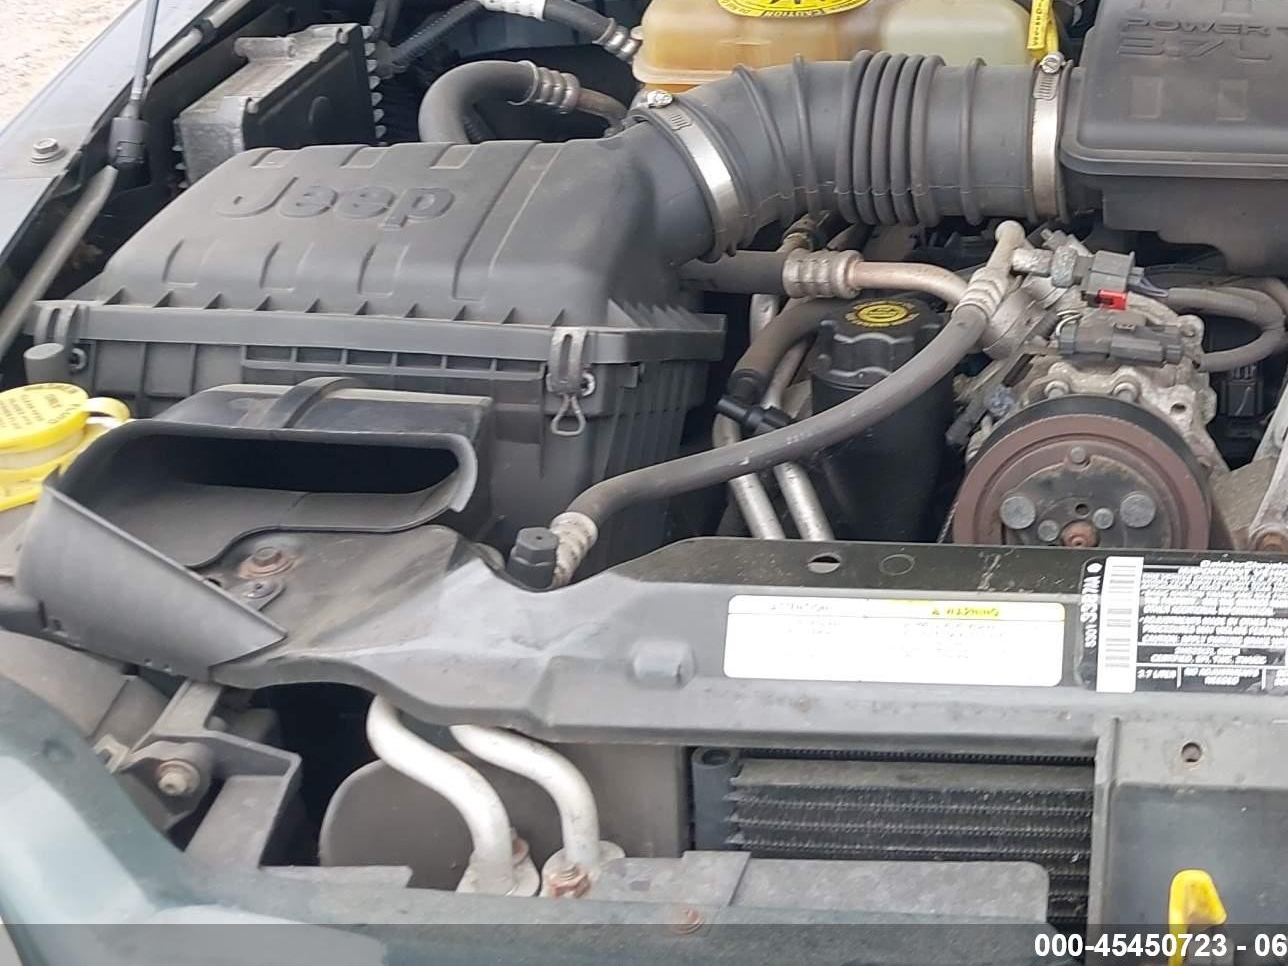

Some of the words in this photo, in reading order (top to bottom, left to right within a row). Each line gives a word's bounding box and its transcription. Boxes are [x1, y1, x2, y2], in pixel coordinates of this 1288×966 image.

[1121, 18, 1270, 37] POWER
[1116, 35, 1273, 63] 3.7L
[216, 176, 455, 232] Jeep
